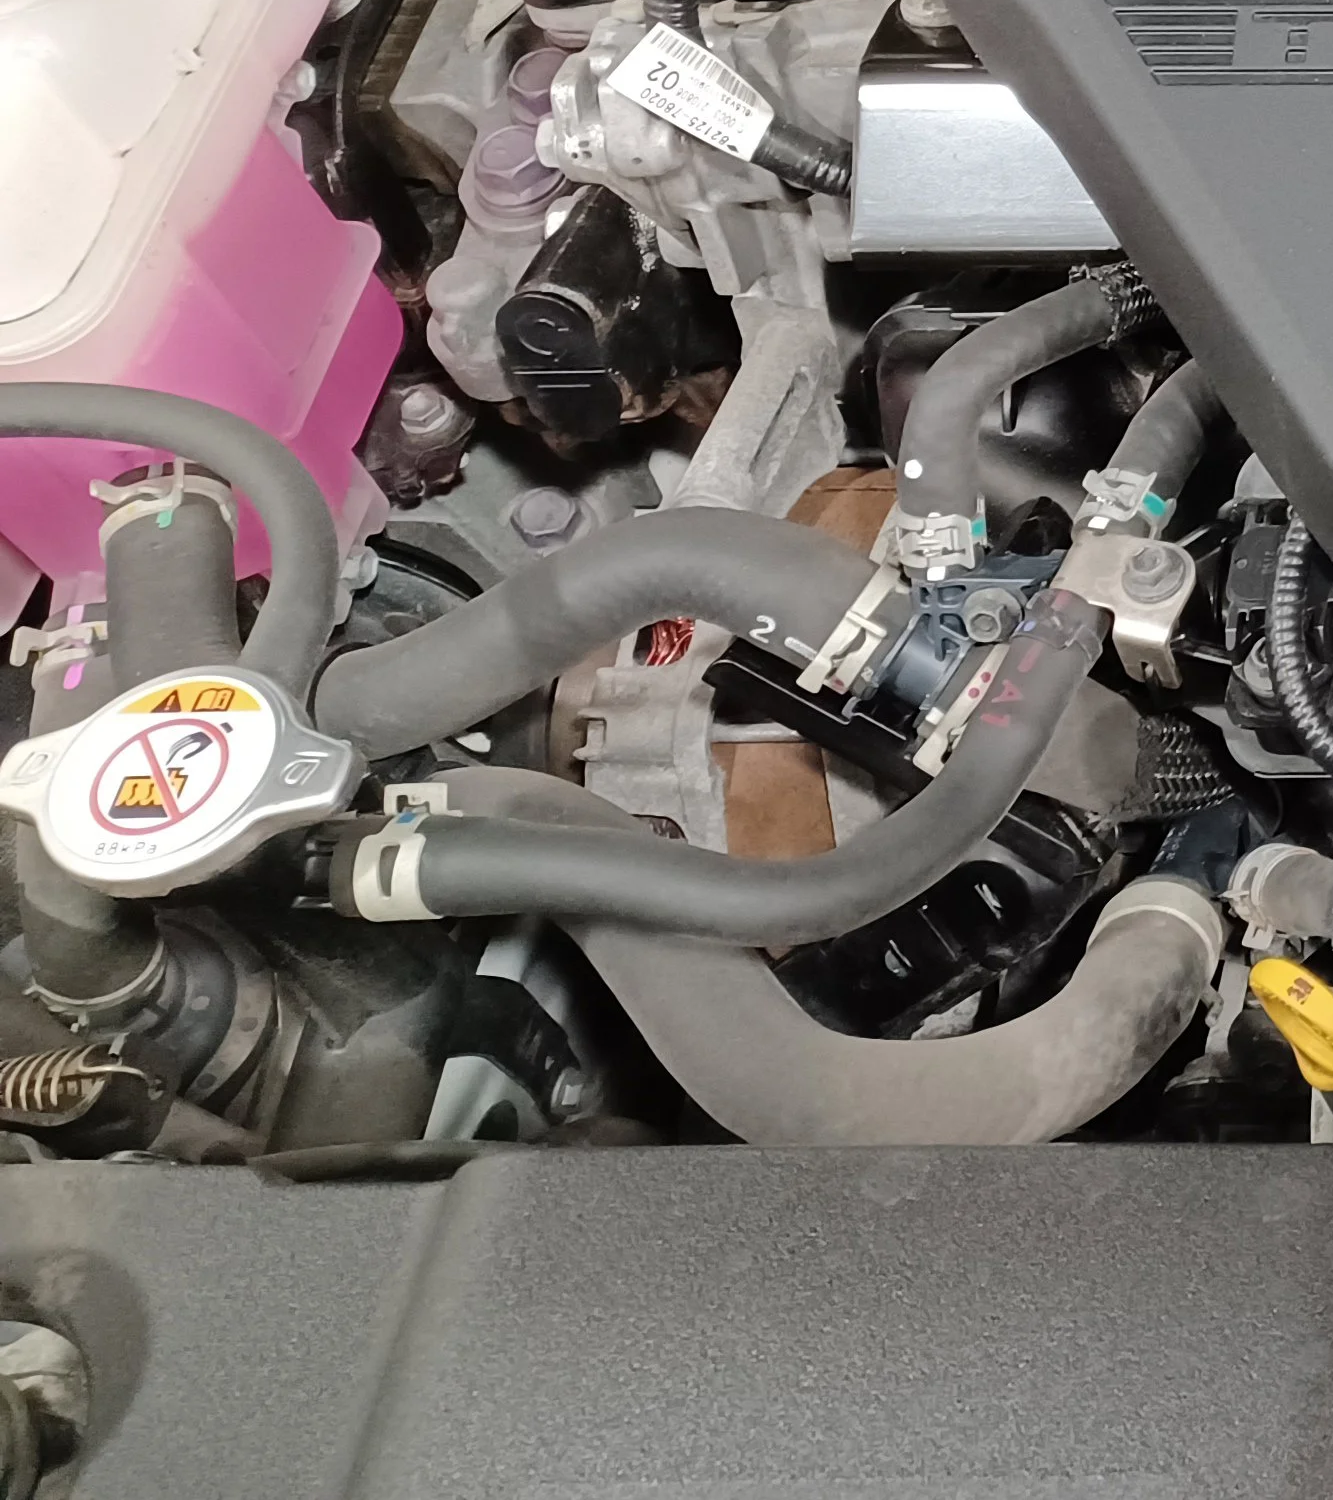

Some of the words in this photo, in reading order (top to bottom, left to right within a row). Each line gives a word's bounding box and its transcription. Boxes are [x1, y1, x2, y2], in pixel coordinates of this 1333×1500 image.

[646, 61, 680, 90] 02
[640, 87, 730, 146] 82125-78020
[748, 615, 776, 644] 2
